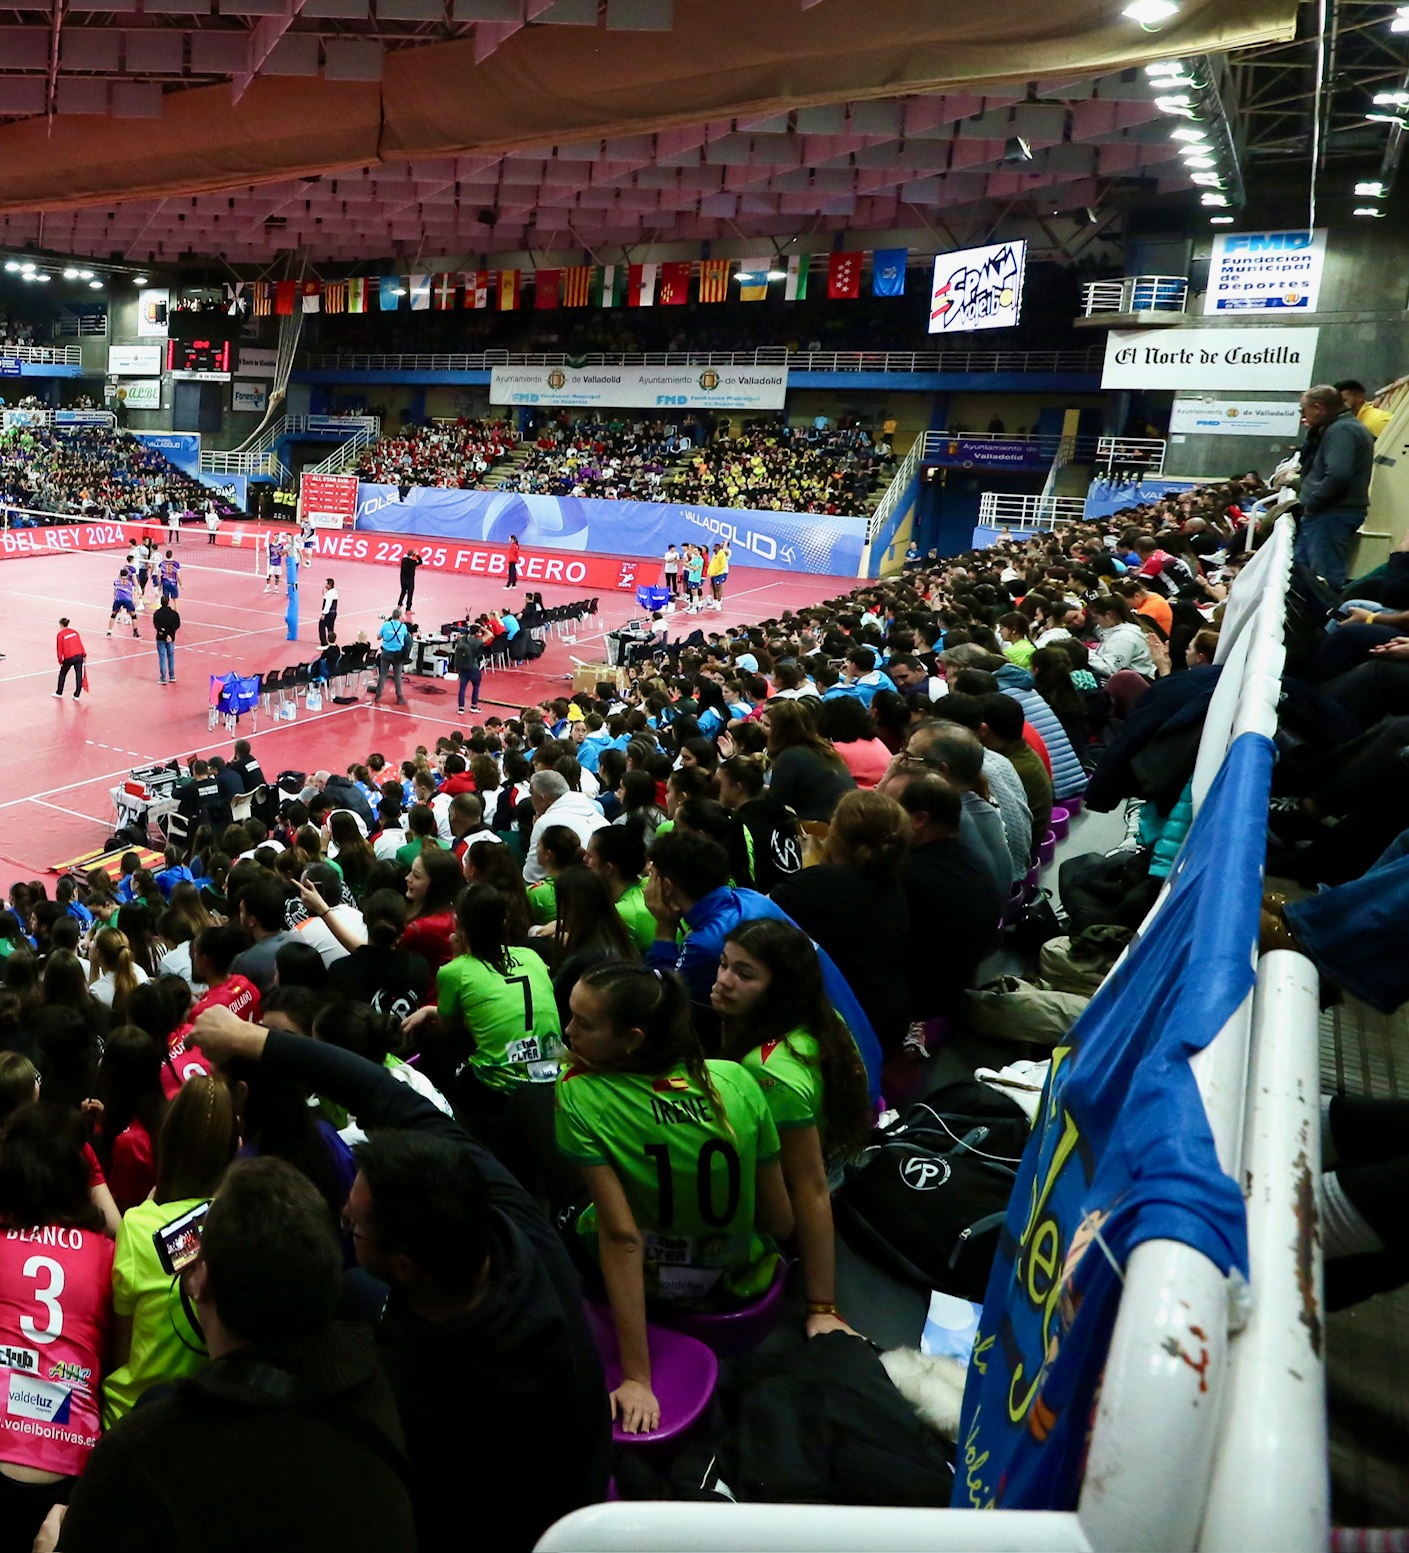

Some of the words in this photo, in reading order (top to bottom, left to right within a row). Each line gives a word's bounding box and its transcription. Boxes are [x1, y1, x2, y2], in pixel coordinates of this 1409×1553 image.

[1224, 233, 1313, 254] FMD
[1221, 263, 1311, 273] Municipal
[1218, 281, 1310, 291] Deportes
[1115, 347, 1137, 365] El
[1144, 347, 1194, 365] Norte
[1200, 349, 1219, 365] de
[1224, 346, 1301, 365] Castilla
[495, 375, 543, 384] Ayuntamiento
[571, 376, 582, 384] de
[583, 376, 621, 384] Valladolid
[638, 376, 693, 385] Ayuntamiento
[724, 377, 736, 385] de
[738, 376, 783, 385] Valladolid
[512, 393, 540, 403] FMD
[656, 395, 688, 405] FMD
[1176, 408, 1223, 416] Ayuntamiento
[1255, 409, 1295, 417] Valladolid
[963, 442, 1022, 452] Ayuntamiento
[973, 453, 1024, 461] Valladolid
[2, 531, 37, 553] DEL
[45, 527, 81, 549] REY
[86, 525, 125, 546] 2024
[684, 510, 777, 561] VALLADOLID
[504, 975, 533, 1032] 7
[649, 1096, 714, 1125] IRENE
[643, 1138, 740, 1228] 10
[19, 1255, 65, 1344] 3
[9, 1390, 53, 1409] valdeluz
